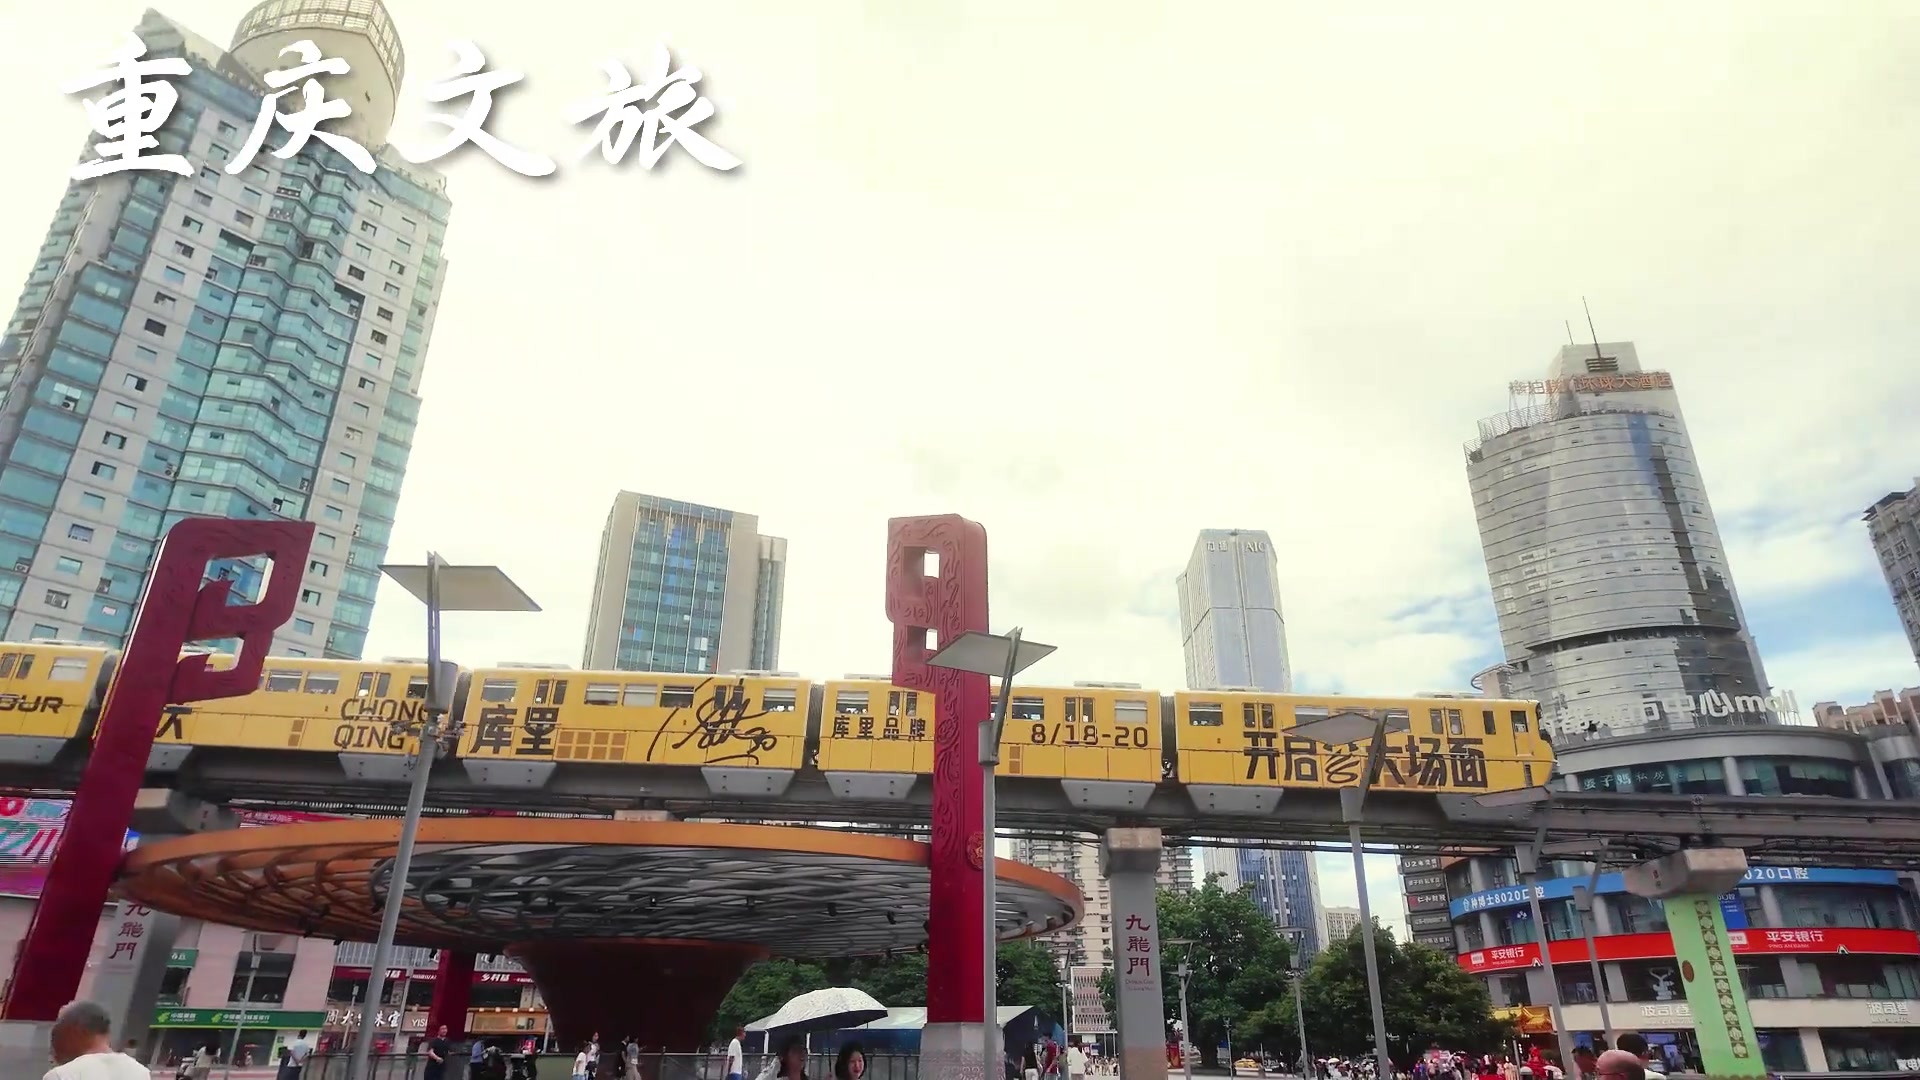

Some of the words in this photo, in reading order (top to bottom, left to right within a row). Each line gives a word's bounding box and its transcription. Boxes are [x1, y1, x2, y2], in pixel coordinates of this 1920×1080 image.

[333, 724, 405, 750] QING
[470, 704, 559, 757] 库里
[831, 714, 927, 741] 库里品牌
[1031, 722, 1149, 749] 8/18-20
[1126, 914, 1151, 976] 九龍門
[1765, 930, 1824, 942] 平安银行
[1491, 947, 1524, 960] 平安银行
